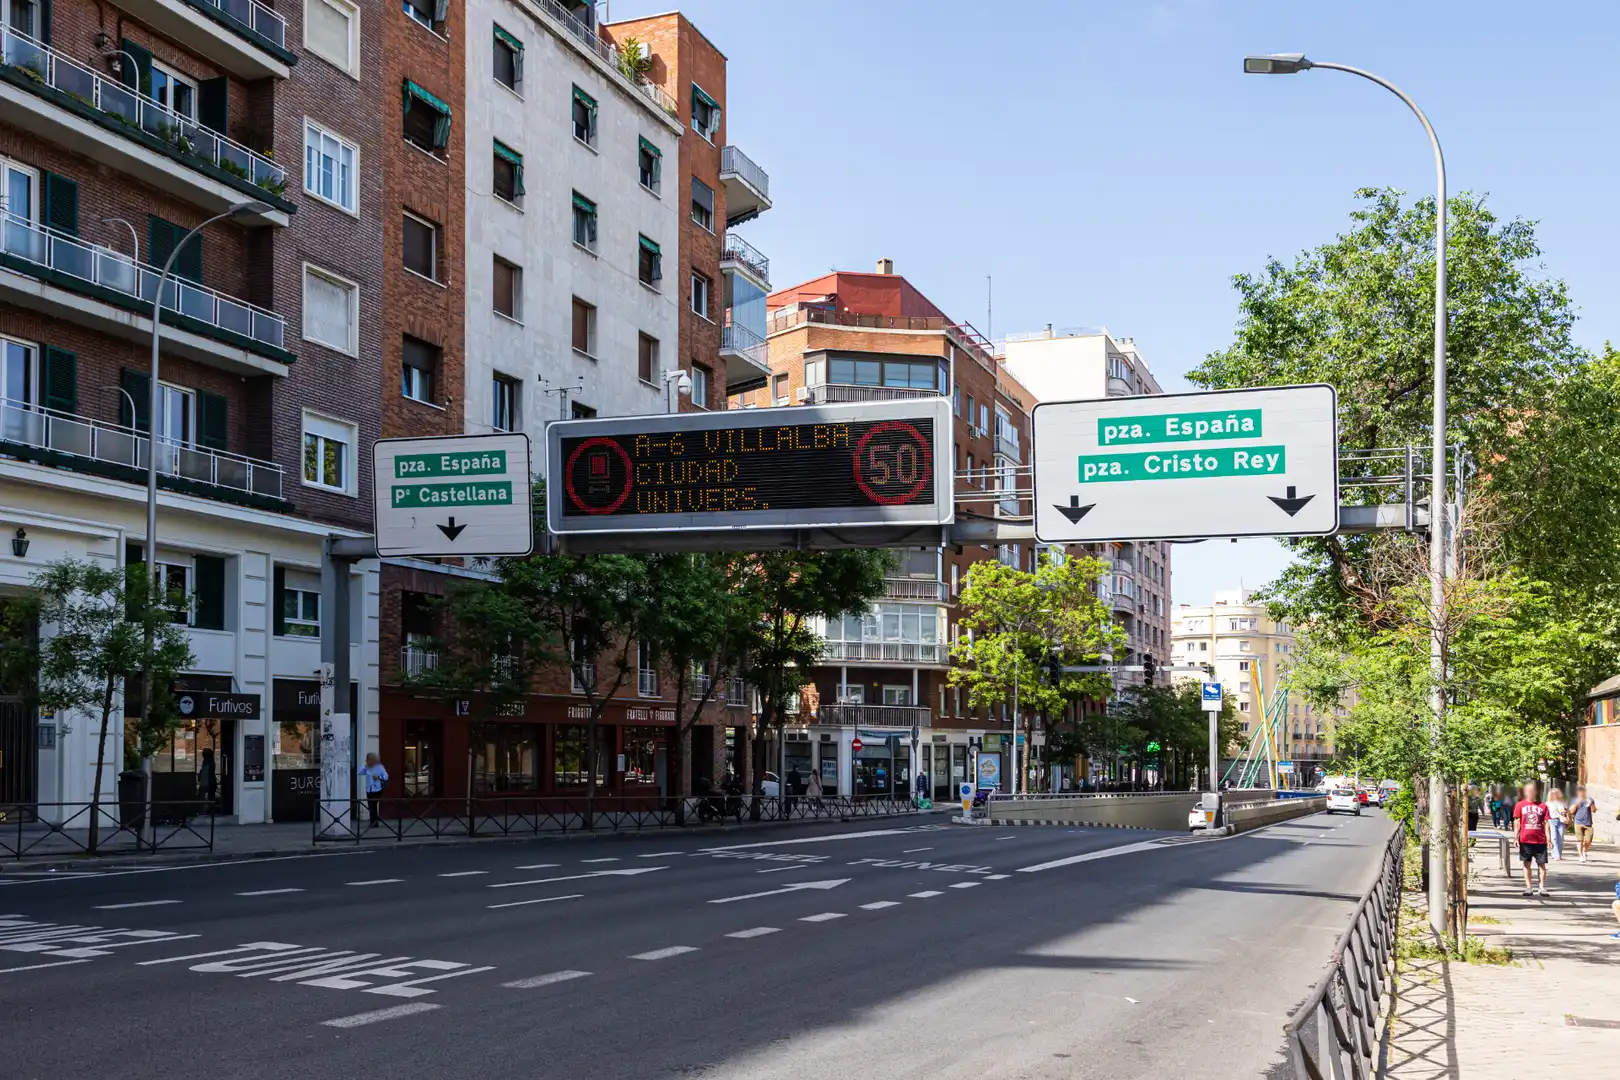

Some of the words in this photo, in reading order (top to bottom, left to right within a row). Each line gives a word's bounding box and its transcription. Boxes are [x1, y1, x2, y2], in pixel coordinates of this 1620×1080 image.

[636, 432, 685, 457] A-6
[705, 423, 849, 453] VILLALBA
[1104, 424, 1151, 444] pza.
[1165, 414, 1255, 437] España
[399, 460, 431, 476] pza.
[441, 453, 501, 474] España
[636, 459, 739, 485] CIUDAD
[869, 443, 917, 485] 50
[1083, 461, 1130, 480] pza.
[1143, 453, 1219, 474] Cristo
[1233, 451, 1280, 472] Rey
[419, 485, 507, 503] Castellana
[637, 486, 769, 514] UNIVERS.
[209, 697, 253, 714] Furtivos
[298, 691, 321, 705] Furtiv
[290, 776, 321, 790] BURG
[846, 858, 992, 874] TUNEL
[136, 941, 497, 998] TUNEL
